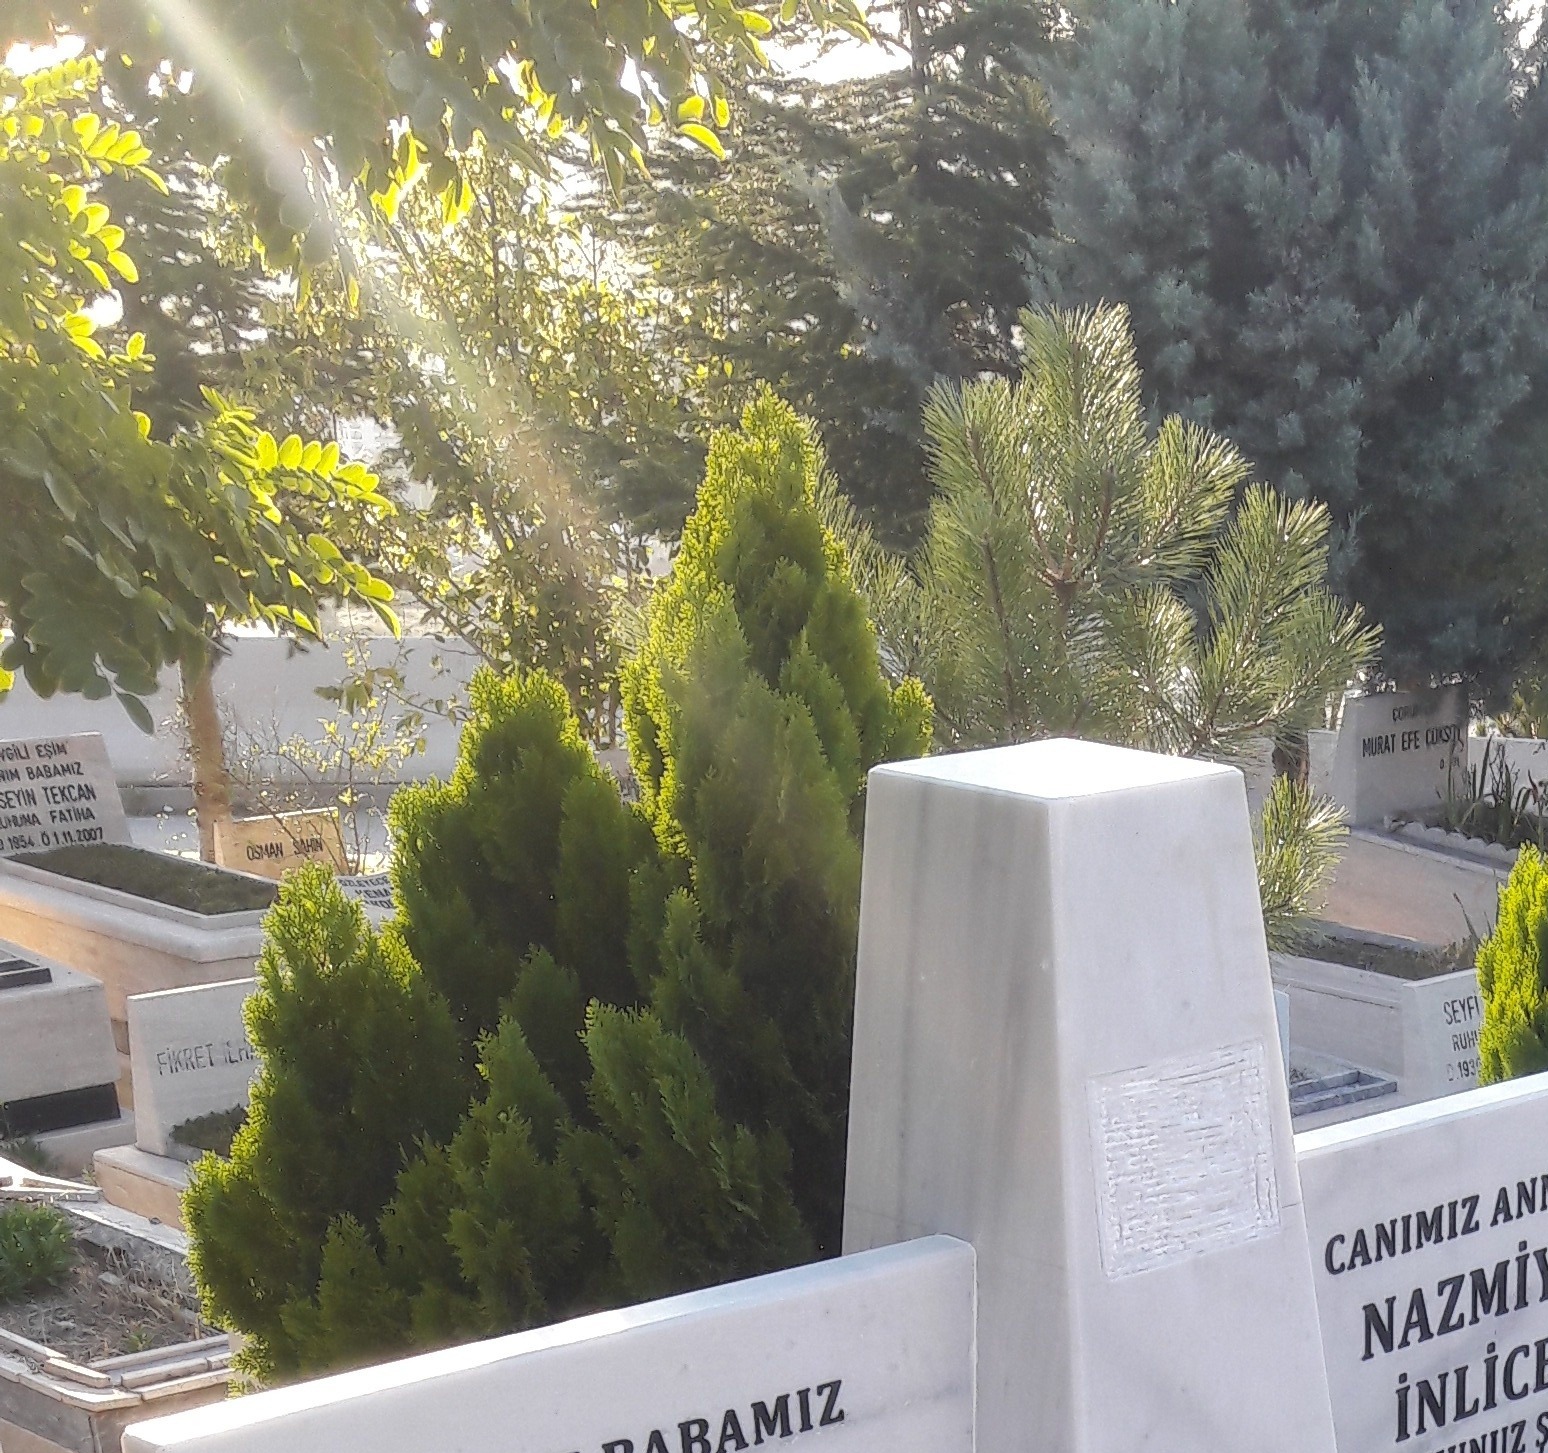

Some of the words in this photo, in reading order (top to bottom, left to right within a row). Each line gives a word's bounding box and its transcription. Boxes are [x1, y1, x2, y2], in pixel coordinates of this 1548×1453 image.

[1362, 734, 1396, 758] MURAT
[1401, 730, 1420, 752] EFE
[26, 762, 84, 780] BABAMIZ
[42, 783, 97, 805] TEKCAN
[246, 841, 284, 861] OSMAN
[156, 1043, 214, 1076] FİKRET
[1324, 1194, 1480, 1276] CANIMIZ
